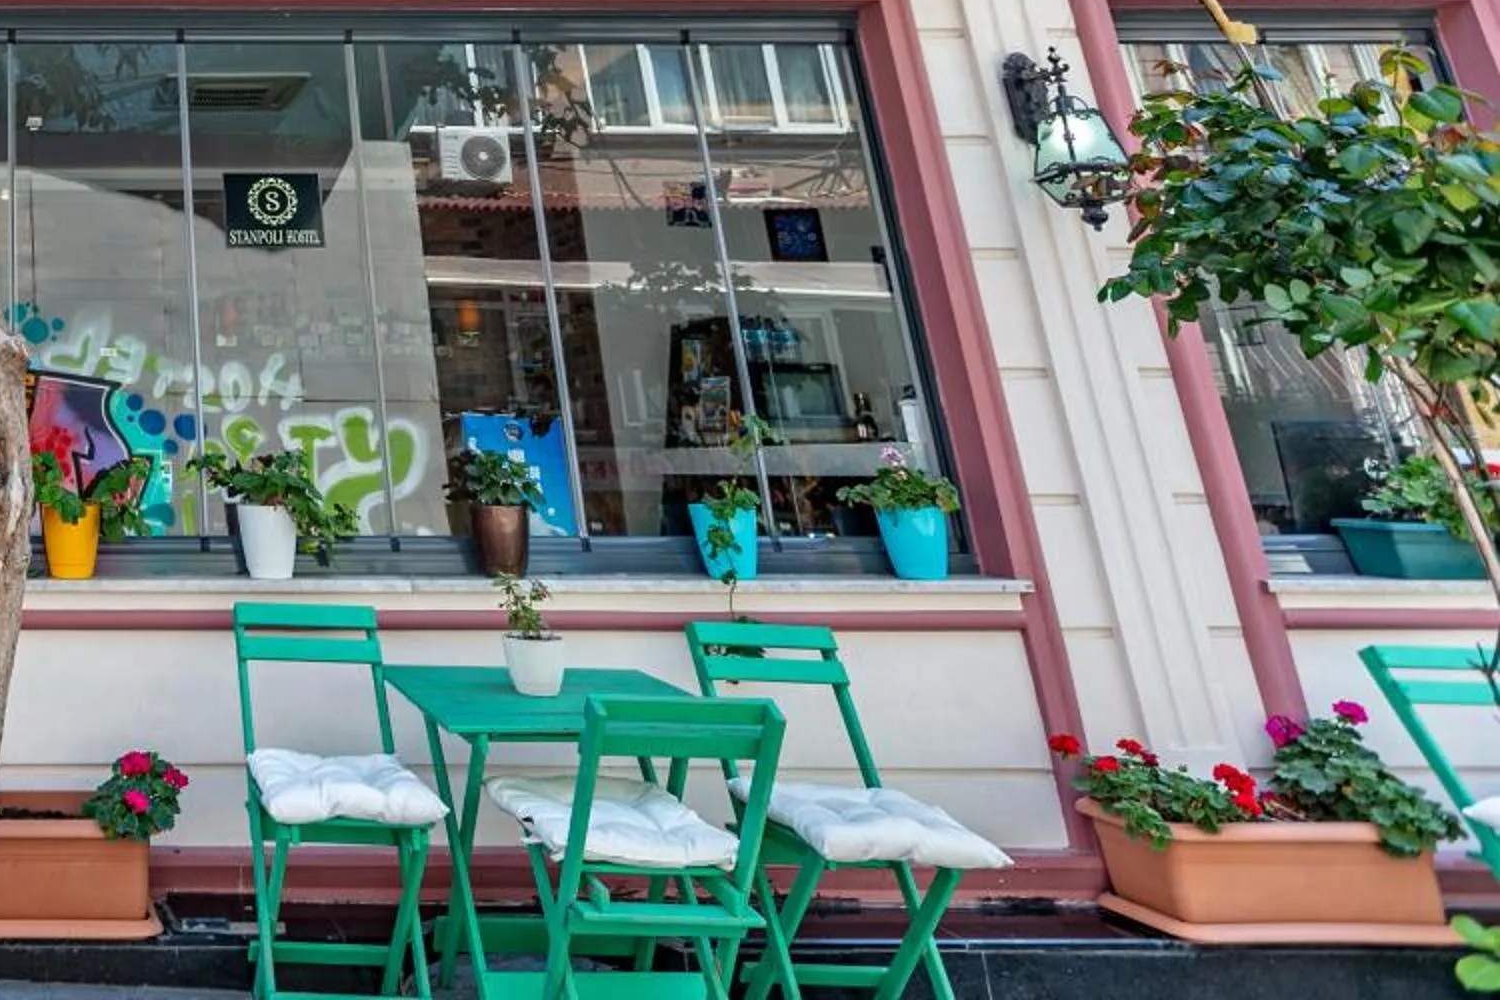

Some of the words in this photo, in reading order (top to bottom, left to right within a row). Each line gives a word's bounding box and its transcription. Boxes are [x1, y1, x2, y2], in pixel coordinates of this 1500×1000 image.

[265, 191, 281, 211] S
[229, 229, 283, 245] STANPOLI
[285, 229, 321, 244] HOSTEL
